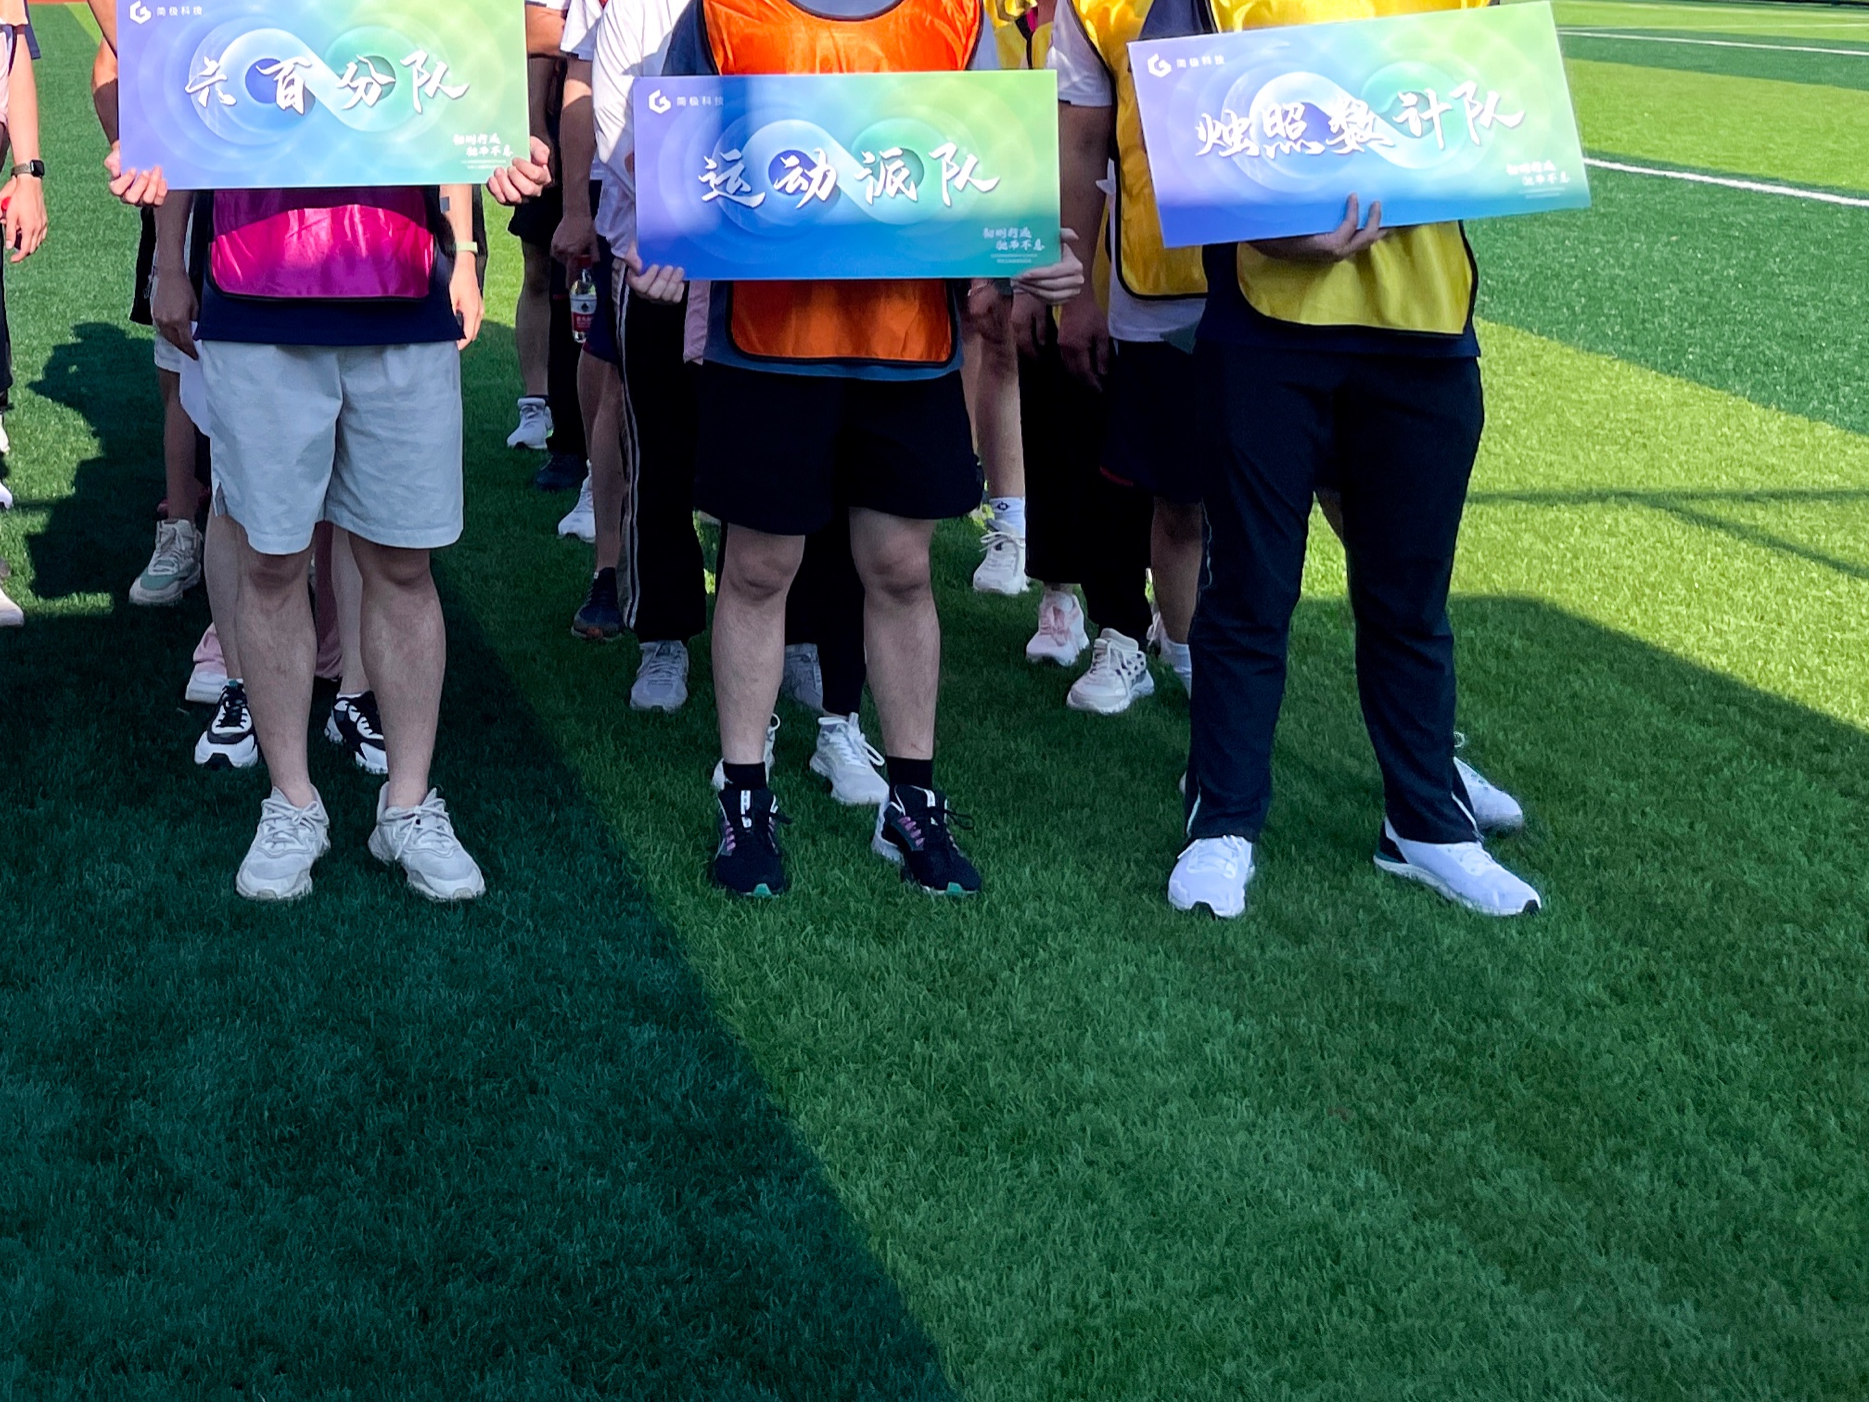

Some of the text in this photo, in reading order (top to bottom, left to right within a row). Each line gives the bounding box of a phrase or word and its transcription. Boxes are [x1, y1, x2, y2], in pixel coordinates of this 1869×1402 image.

[185, 50, 470, 114] 六百分队
[698, 142, 1001, 209] 运动派队
